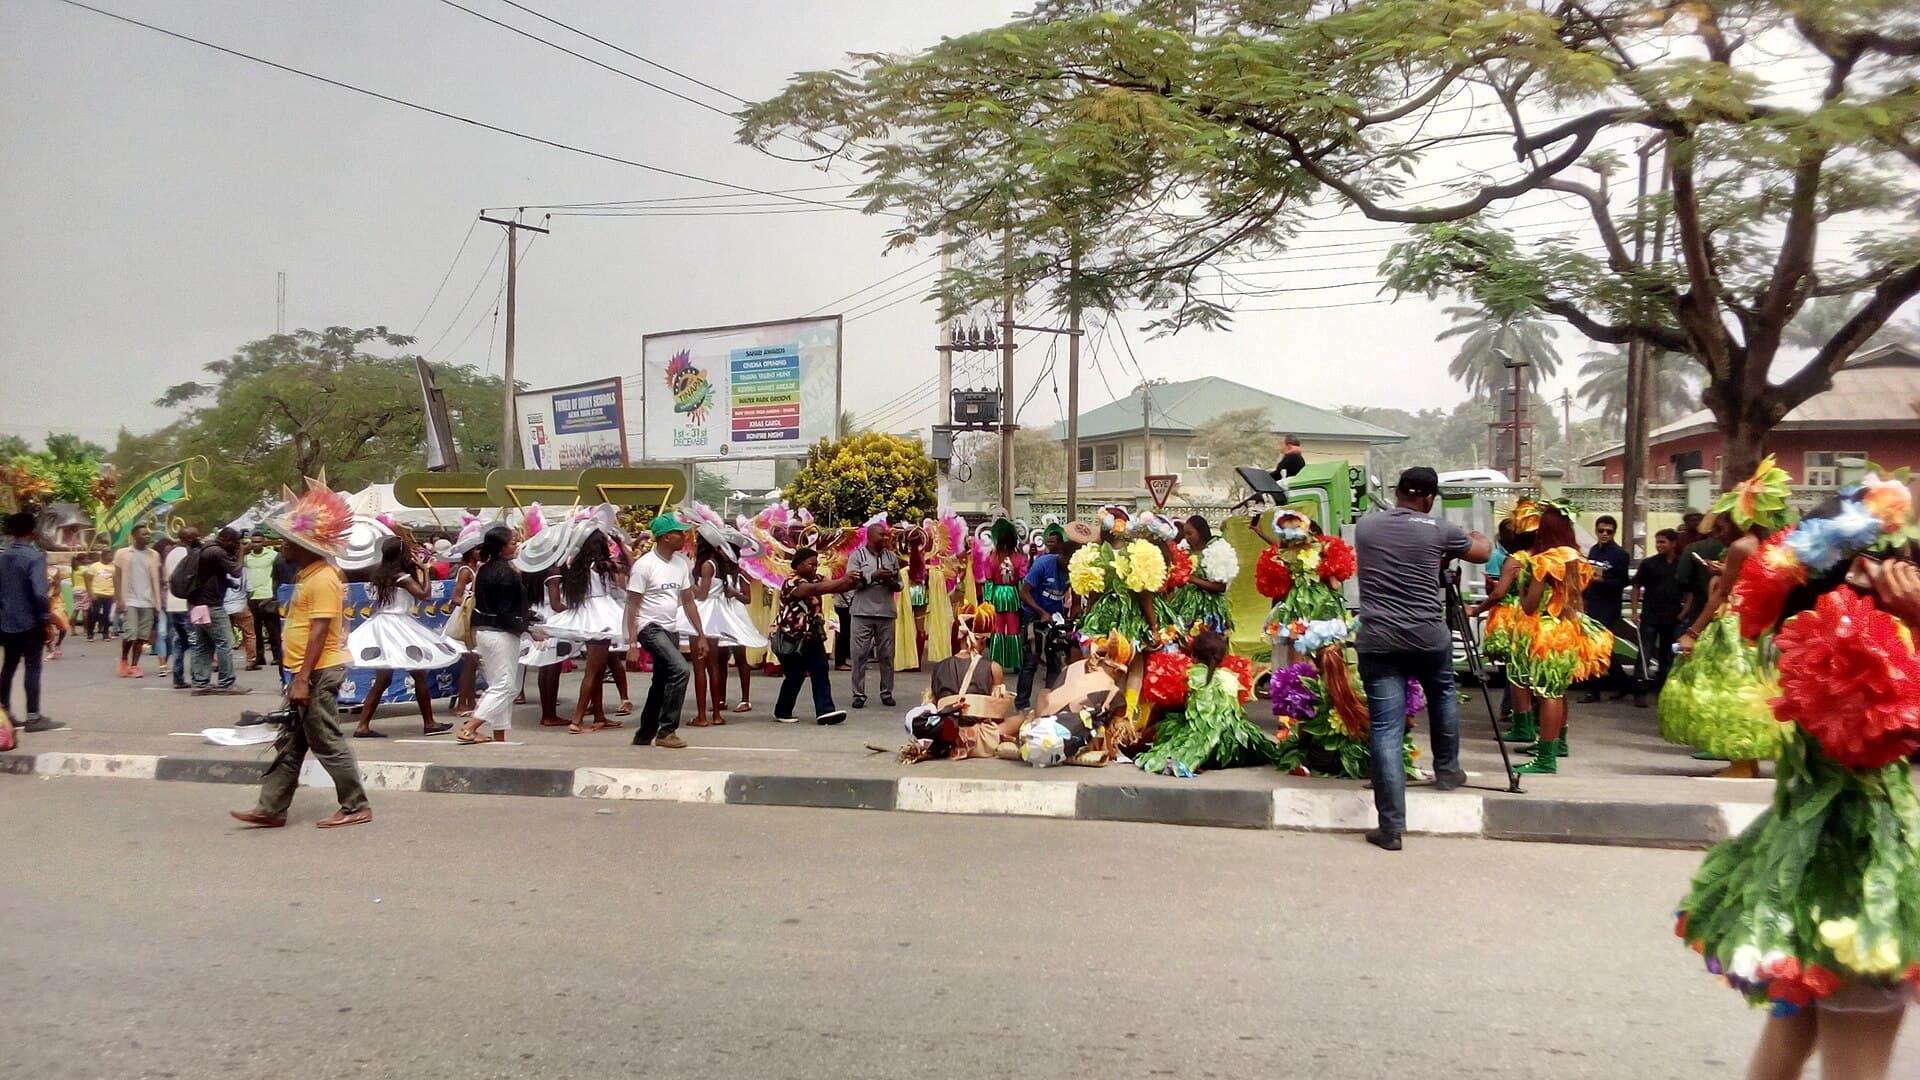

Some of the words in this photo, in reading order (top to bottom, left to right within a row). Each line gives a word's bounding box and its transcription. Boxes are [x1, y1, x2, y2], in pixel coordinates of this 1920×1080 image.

[680, 378, 704, 402] TINAPA
[769, 394, 791, 402] GROOVE
[691, 428, 708, 438] 31st
[673, 438, 708, 447] DECEMBER
[1152, 480, 1169, 488] GIVE
